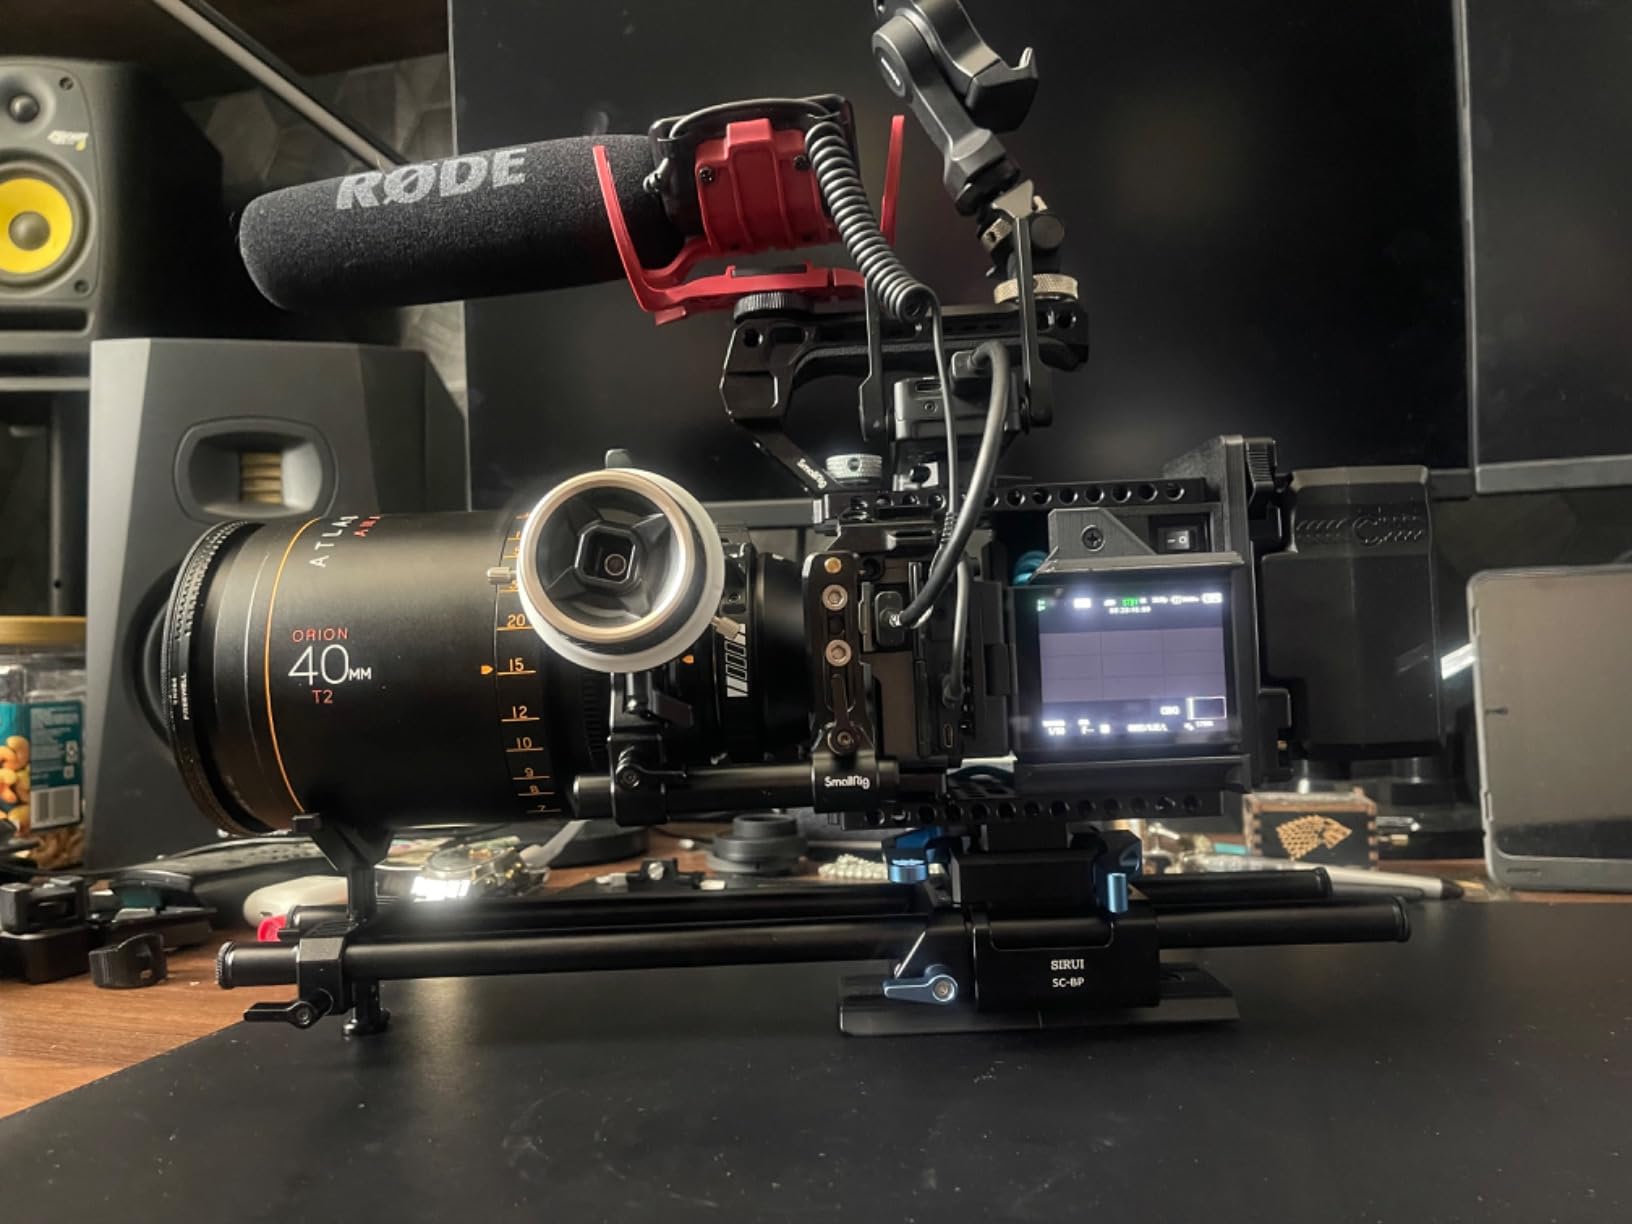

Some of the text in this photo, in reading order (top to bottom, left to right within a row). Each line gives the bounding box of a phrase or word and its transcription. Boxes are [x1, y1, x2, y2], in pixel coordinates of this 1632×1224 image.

[337, 148, 527, 210] RØDE
[507, 613, 526, 628] 20
[292, 627, 348, 642] ORION
[509, 657, 524, 672] 15
[312, 689, 333, 704] T2
[512, 705, 528, 720] 12
[516, 736, 532, 750] 10
[524, 767, 534, 778] 9
[824, 775, 870, 790] SmallRig
[1050, 958, 1085, 970] SIRUI
[1052, 976, 1085, 988] SC-BP
